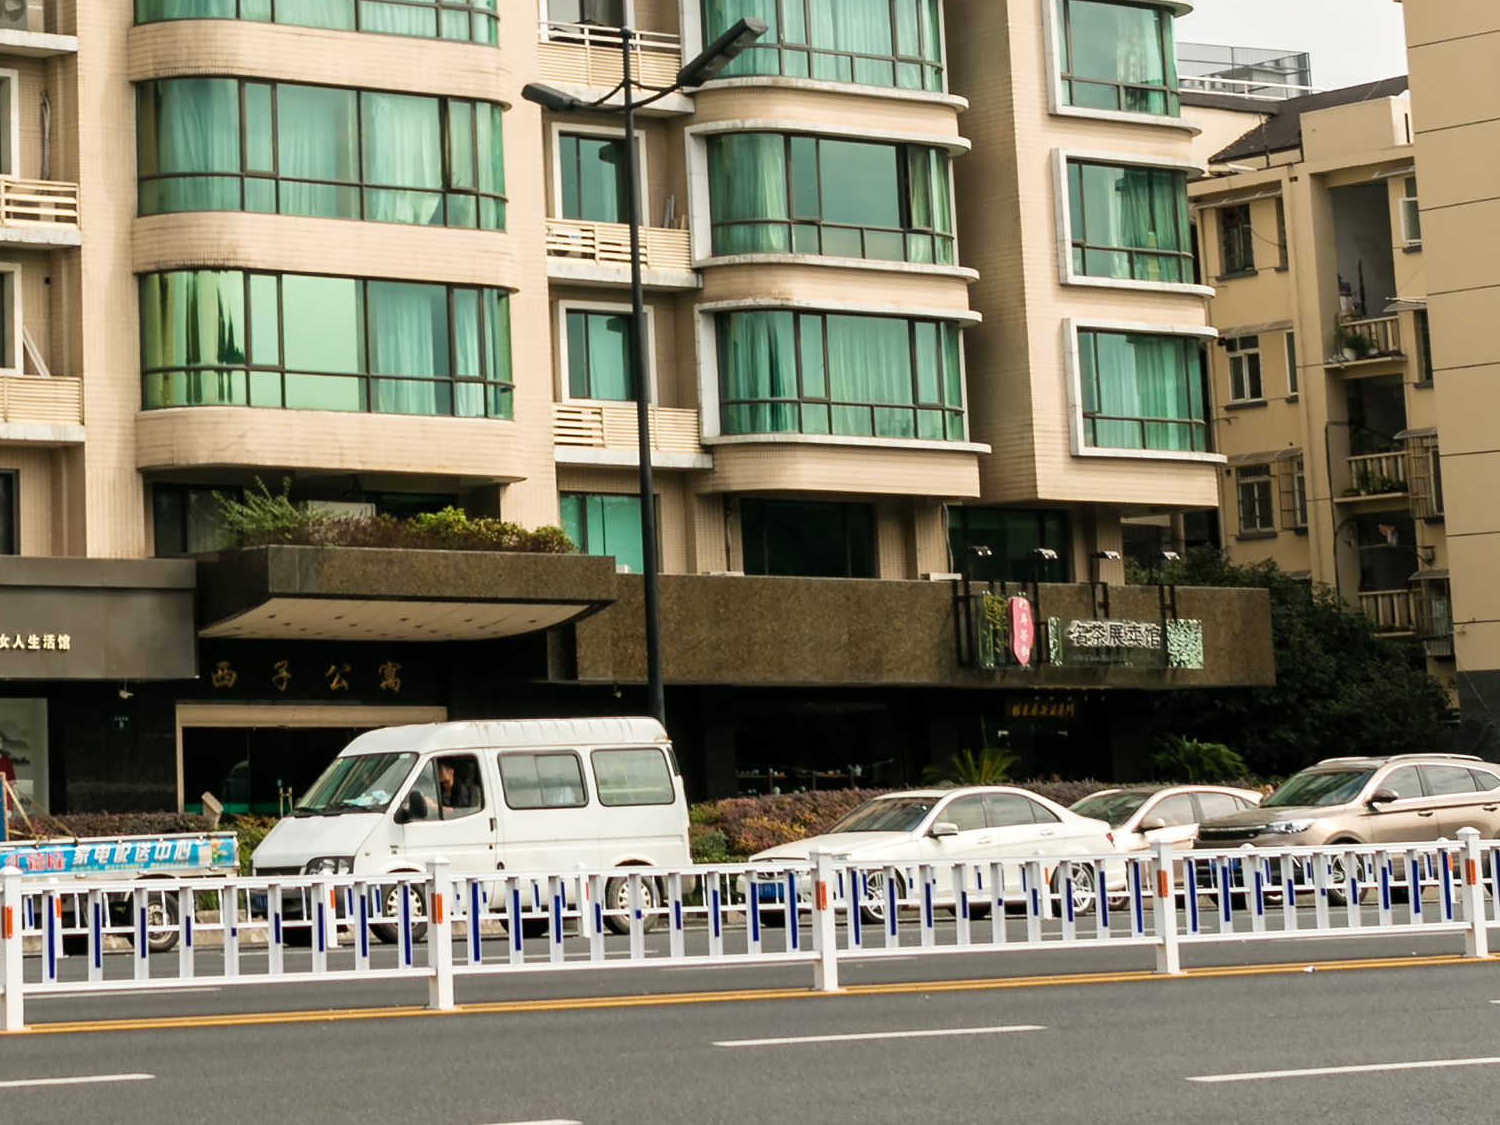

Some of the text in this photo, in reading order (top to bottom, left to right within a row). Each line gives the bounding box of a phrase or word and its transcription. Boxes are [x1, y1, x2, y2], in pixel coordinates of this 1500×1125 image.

[1066, 619, 1162, 649] 名茶展卖馆
[71, 839, 193, 865] 家电配送中心
